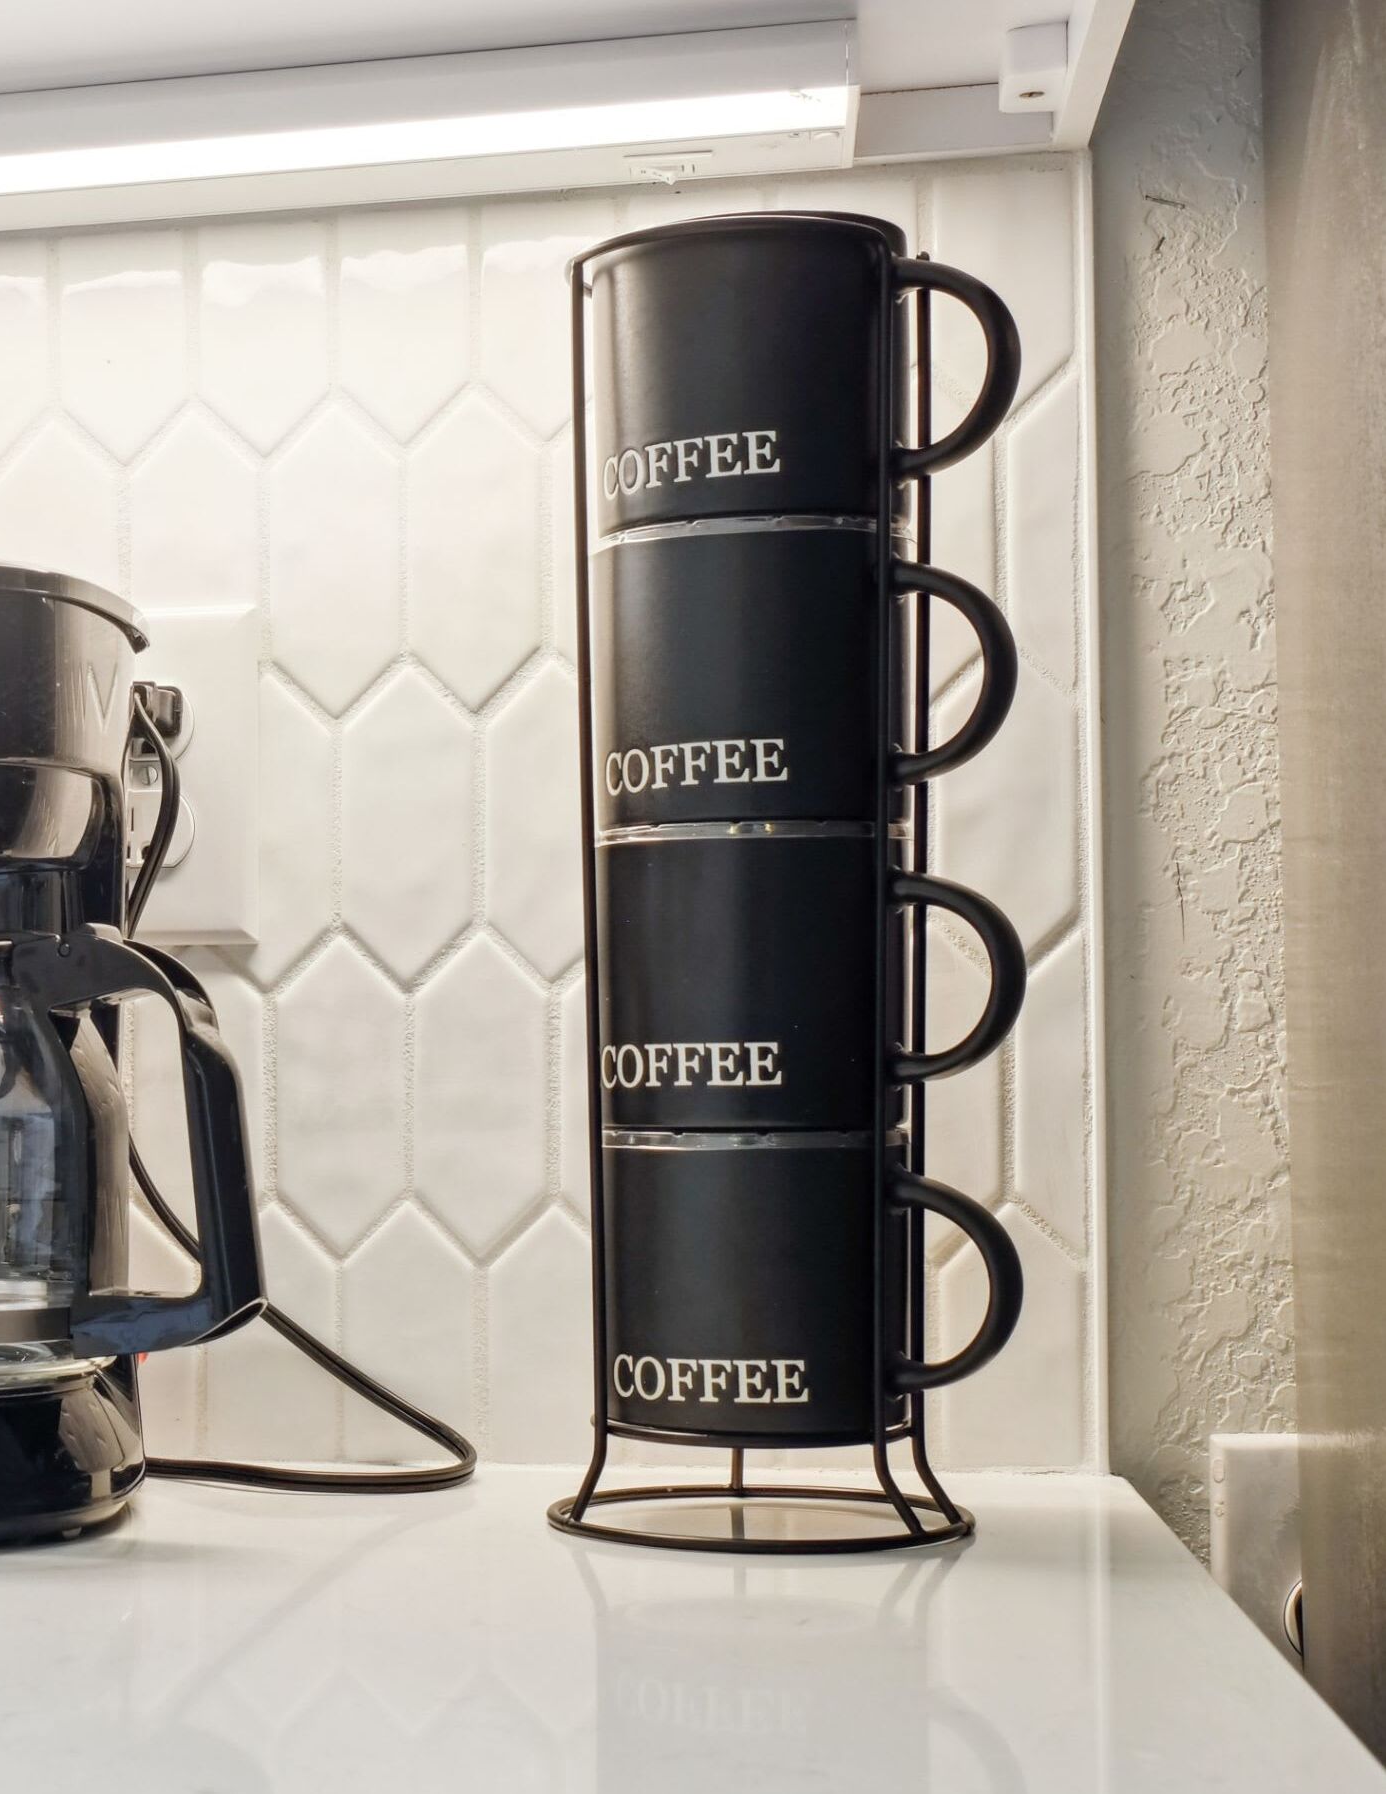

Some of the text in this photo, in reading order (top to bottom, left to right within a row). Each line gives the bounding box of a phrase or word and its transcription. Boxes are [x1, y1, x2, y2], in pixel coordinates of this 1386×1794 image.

[603, 430, 781, 500] COFFEE
[605, 738, 788, 797] COFFEE
[601, 1041, 783, 1089] COFFEE
[613, 1353, 809, 1404] COFFEE
